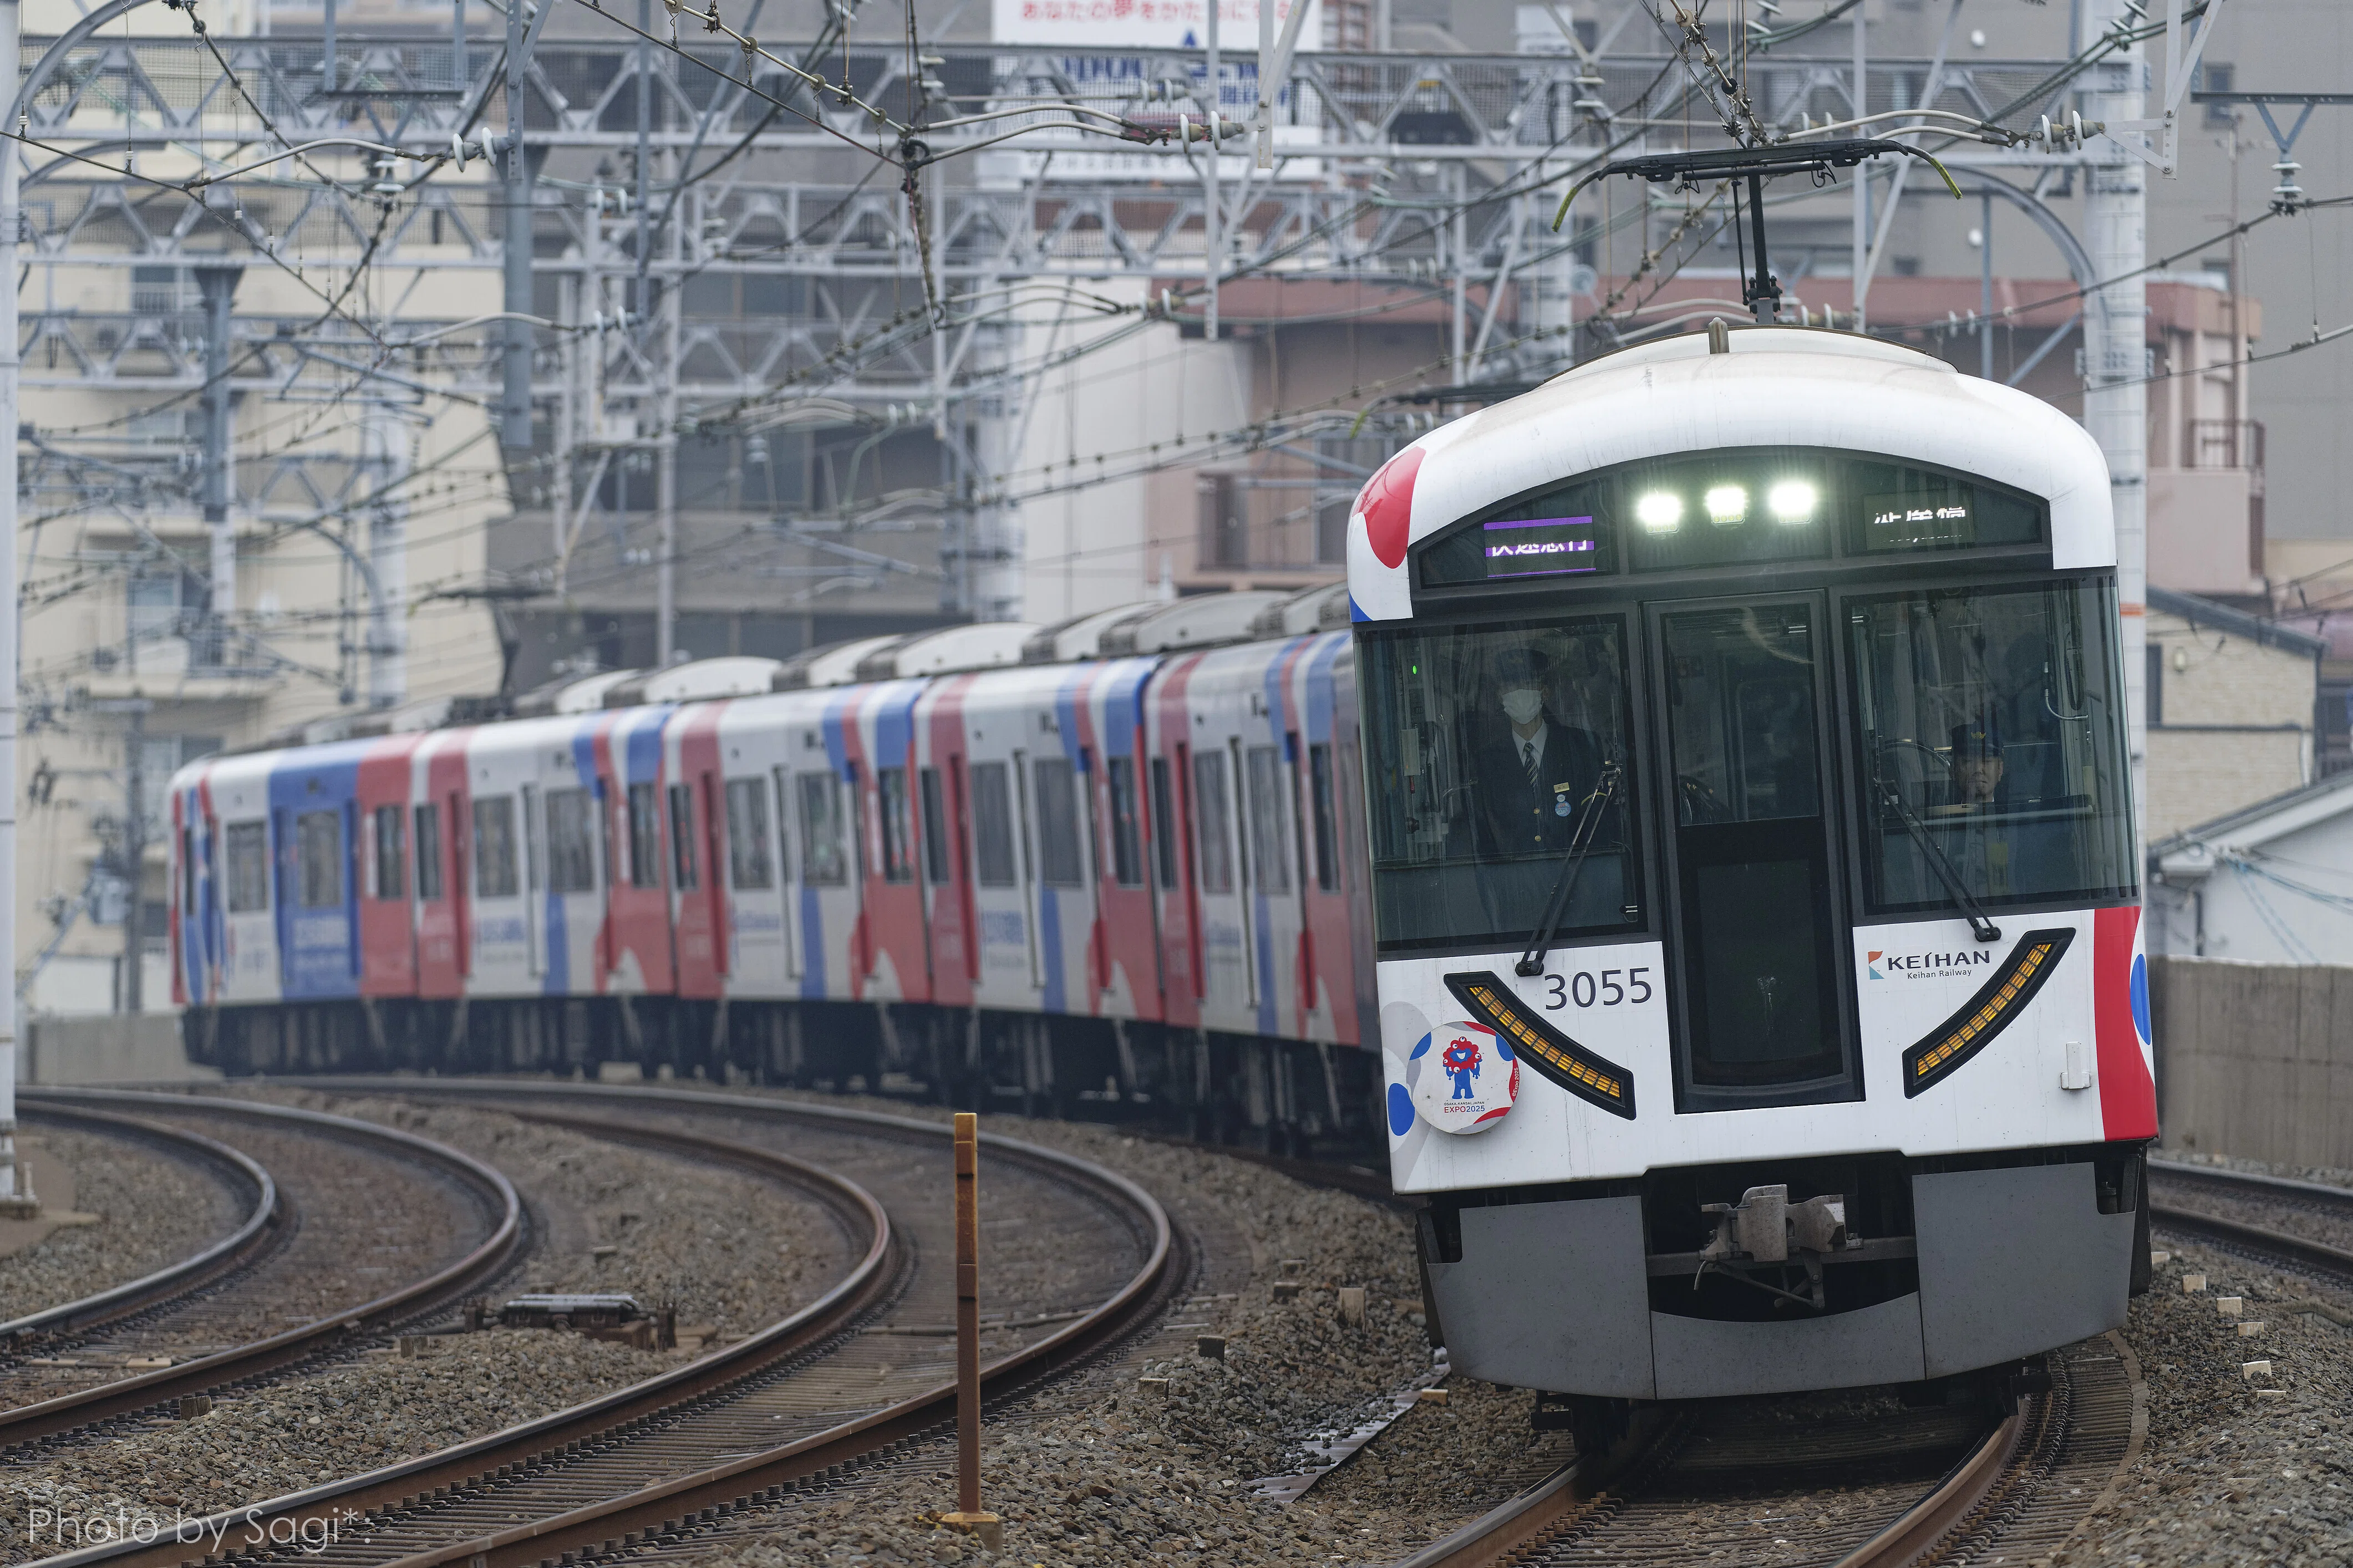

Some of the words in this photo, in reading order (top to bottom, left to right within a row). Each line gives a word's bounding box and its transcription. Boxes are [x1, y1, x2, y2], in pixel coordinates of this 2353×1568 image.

[1887, 950, 1990, 971] KEIHAN
[1907, 971, 1936, 979] Keihan
[1544, 967, 1652, 1010] 3055
